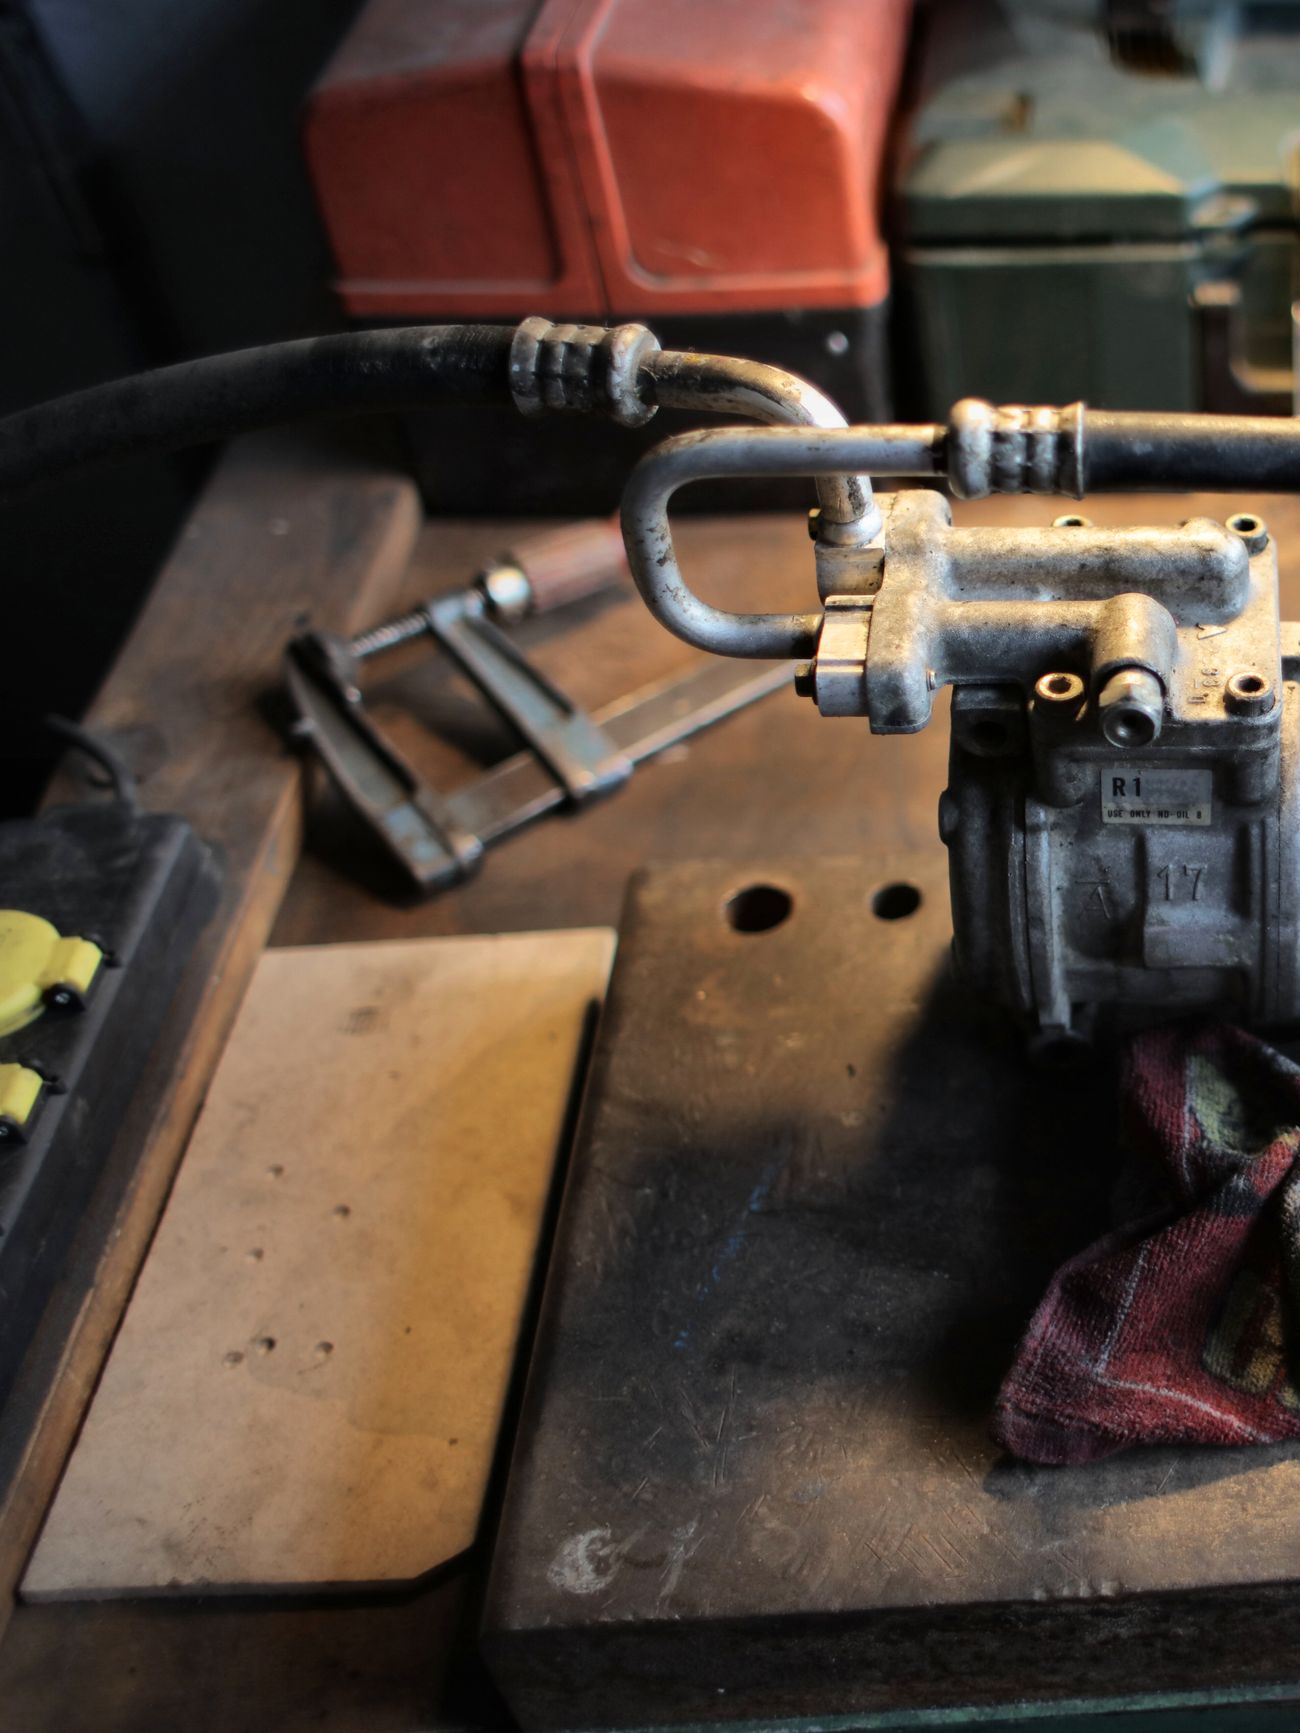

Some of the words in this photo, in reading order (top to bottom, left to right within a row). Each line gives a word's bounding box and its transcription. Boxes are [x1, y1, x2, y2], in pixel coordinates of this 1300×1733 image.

[1107, 809, 1124, 819] USE
[1129, 810, 1151, 819] ONLY
[1156, 863, 1207, 901] 17
